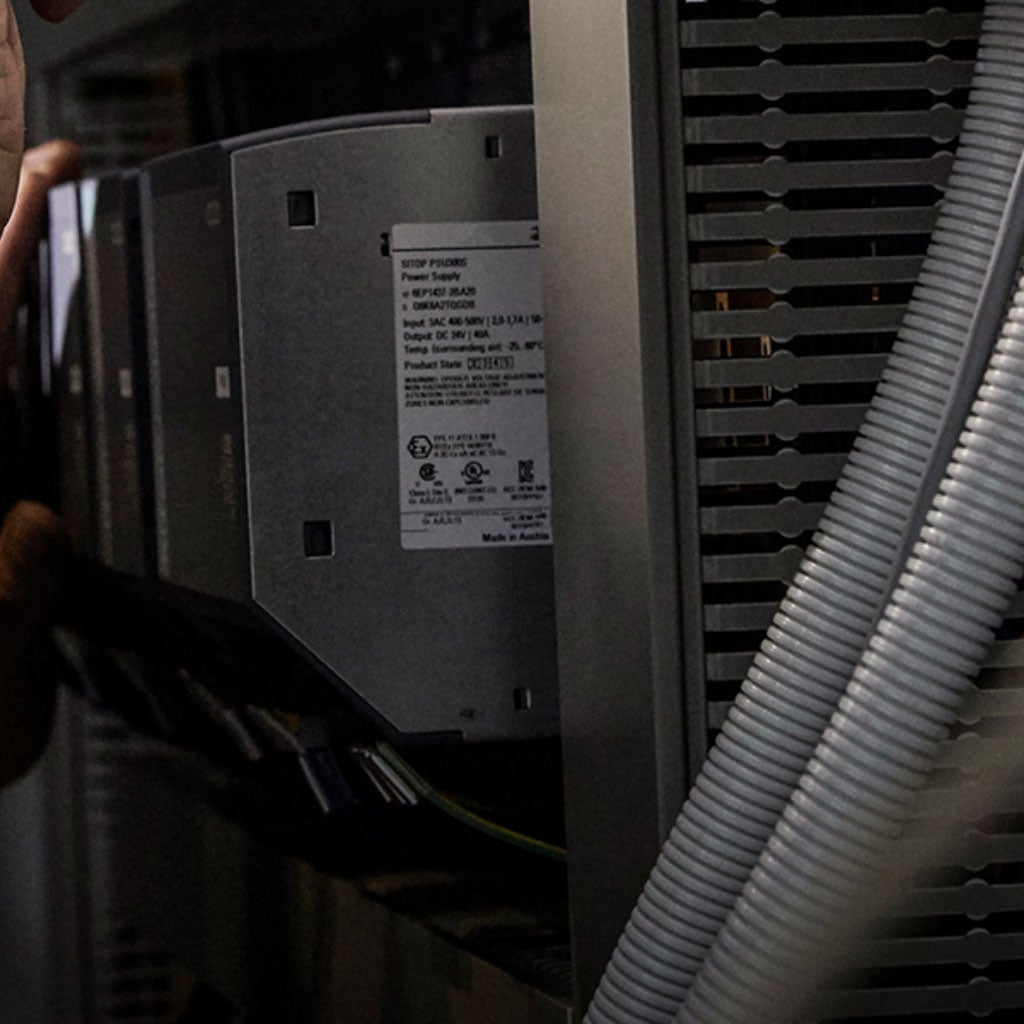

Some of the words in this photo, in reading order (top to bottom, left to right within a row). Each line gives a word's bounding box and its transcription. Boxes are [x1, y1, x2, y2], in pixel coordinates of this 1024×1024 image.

[401, 272, 429, 281] Power
[432, 271, 461, 282] Supply
[404, 360, 437, 370] Product
